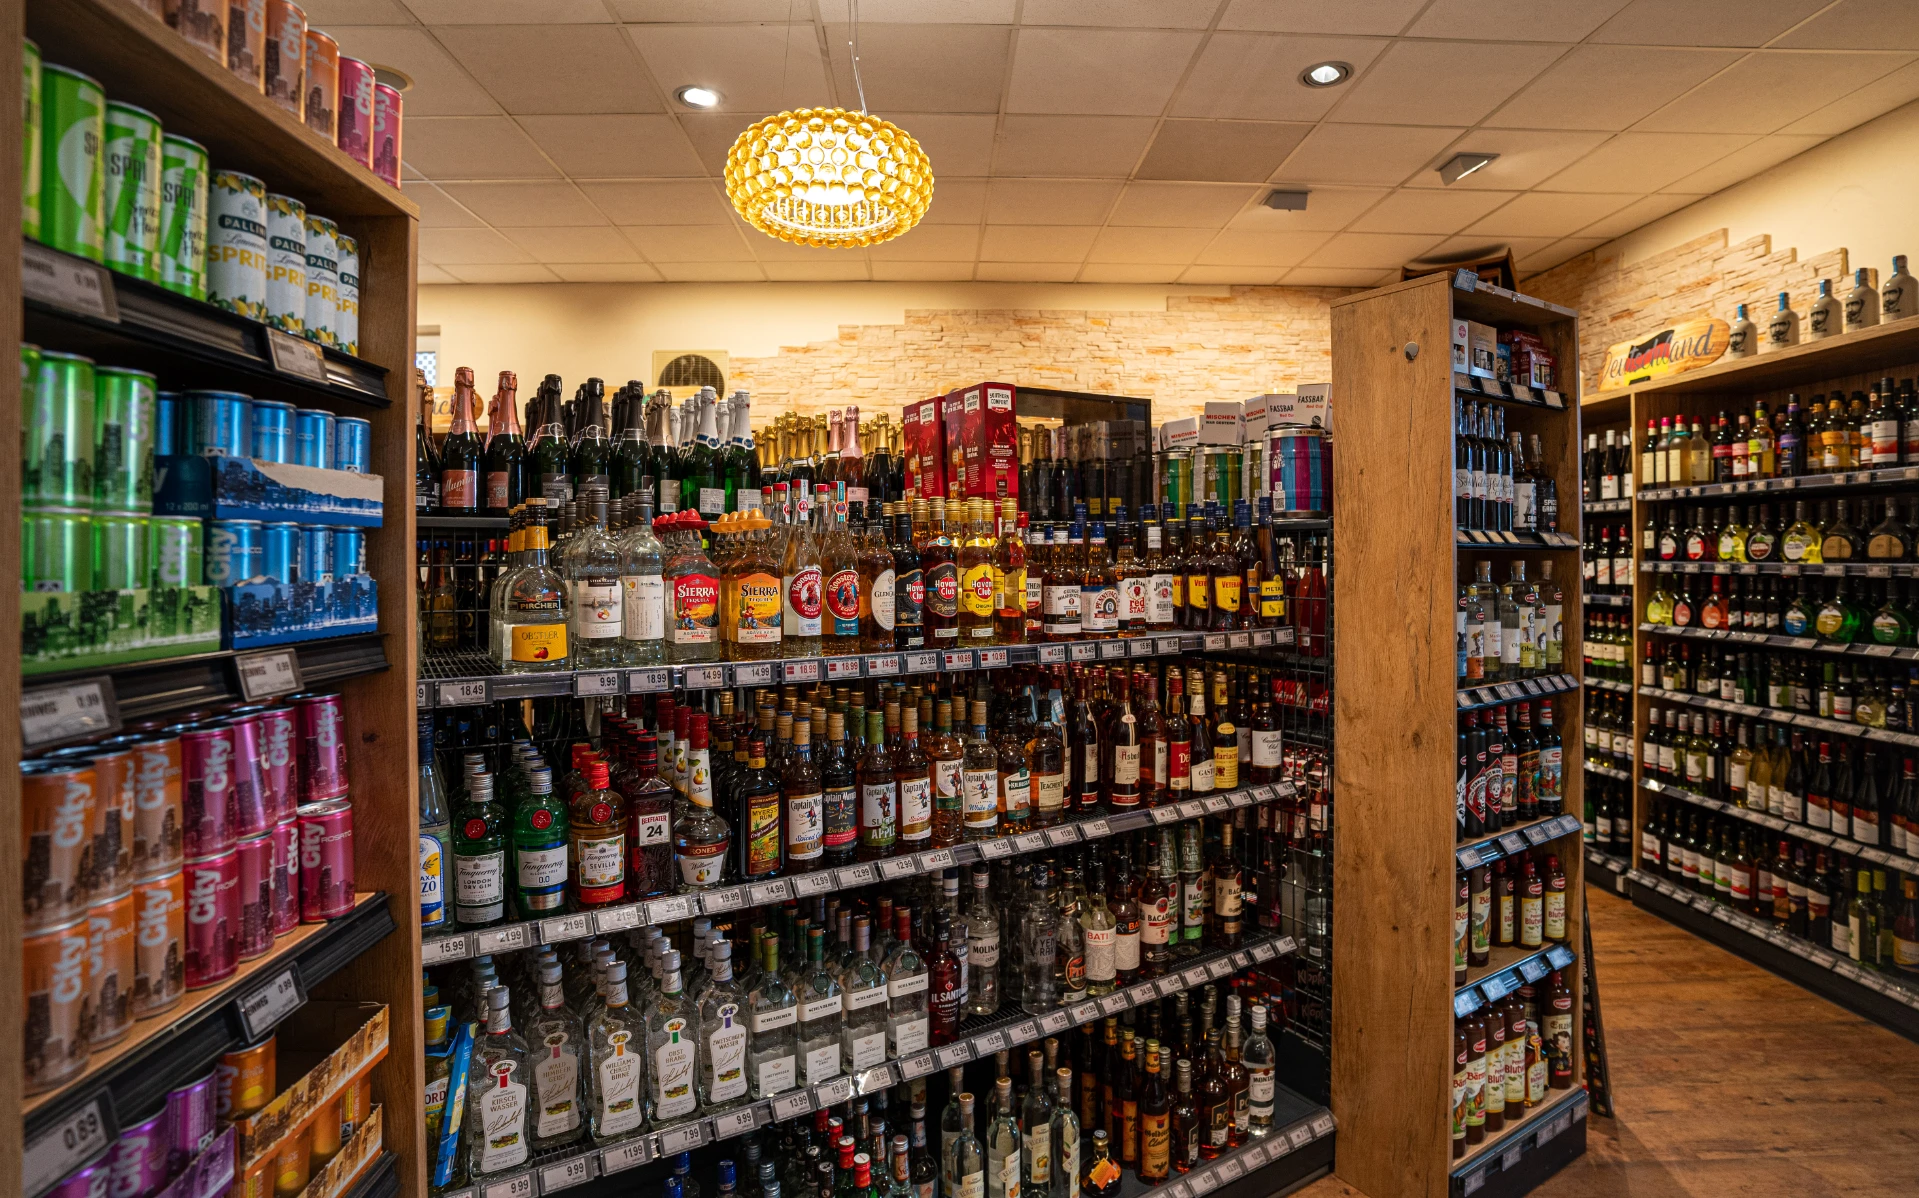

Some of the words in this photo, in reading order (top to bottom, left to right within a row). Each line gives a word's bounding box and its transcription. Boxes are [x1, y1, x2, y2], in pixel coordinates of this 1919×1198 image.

[281, 8, 302, 61] City
[355, 69, 374, 117] City
[374, 89, 392, 132] City
[1297, 395, 1324, 404] FASSBAR
[1245, 407, 1266, 418] MISCHEN
[1269, 404, 1294, 413] FASSBAR
[1171, 430, 1197, 440] MISCHEN
[677, 583, 715, 598] SIERRA
[740, 583, 779, 597] SIERRA
[941, 587, 955, 596] Club
[977, 587, 991, 596] Club
[520, 602, 559, 610] PIRCHER
[1130, 597, 1145, 607] red
[521, 630, 559, 641] OBSTLER
[842, 661, 859, 672] 18.99
[881, 659, 898, 669] 14.99
[919, 656, 936, 666] 23.99
[750, 666, 771, 678] 14.99
[799, 664, 817, 674] 18.99
[646, 673, 667, 684] 18.99
[702, 670, 722, 680] 14.99
[600, 675, 616, 687] 9.99
[1906, 701, 1915, 729] MERLOT
[318, 703, 339, 748] City
[268, 717, 293, 767] City
[204, 739, 232, 793] City
[137, 751, 170, 812] City
[965, 772, 984, 782] Captain
[866, 787, 886, 796] Captain
[903, 782, 923, 794] Captain
[790, 798, 813, 811] Captain
[52, 781, 92, 848] City
[641, 814, 667, 825] BEEFEATER
[759, 813, 773, 821] RUM
[646, 825, 664, 838] 24
[871, 824, 896, 840] APPLE
[302, 822, 326, 869] City
[1026, 835, 1042, 845] 14.99
[689, 846, 718, 855] RONER
[806, 841, 819, 851] 0.0
[993, 841, 1009, 851] 12.99
[586, 852, 618, 861] Tanqueray
[522, 858, 565, 872] Tanqueray
[589, 861, 616, 870] SEVILLA
[896, 861, 913, 870] 12.99
[458, 866, 498, 878] Tanqueray
[853, 869, 870, 879] 12.99
[538, 875, 551, 884] 0.0
[811, 877, 829, 887] 12.99
[765, 884, 785, 895] 14.99
[189, 869, 222, 926] City
[721, 892, 740, 903] 19.99
[139, 888, 172, 948] City
[1087, 931, 1109, 941] BATI
[439, 940, 464, 953] 15.99
[53, 936, 87, 1005] City
[855, 991, 883, 1003] SCHLADERER
[931, 993, 939, 1003] IL
[1112, 996, 1125, 1006] 24.99
[760, 1012, 792, 1024] SCHLADERER
[1051, 1014, 1067, 1026] 18.99
[1020, 1024, 1035, 1035] 15.99
[712, 1032, 745, 1047] ZWETSCHGEN
[718, 1039, 739, 1051] WASSER
[987, 1034, 1002, 1046] 13.99
[668, 1048, 683, 1057] OBST
[951, 1045, 968, 1057] 12.99
[605, 1057, 636, 1070] WILLIAMS
[665, 1053, 687, 1063] BRAND
[915, 1057, 931, 1068] 19.99
[547, 1061, 567, 1070] WALD
[609, 1065, 632, 1075] CHRIST
[543, 1066, 572, 1077] HIMBEER
[610, 1071, 630, 1081] BIRNE
[548, 1073, 566, 1082] GEIST
[831, 1083, 849, 1096] 19.99
[491, 1094, 517, 1105] KIRSCH
[789, 1097, 808, 1110] 13.99
[490, 1101, 519, 1112] WASSER
[736, 1112, 752, 1126] 9.99
[63, 1112, 99, 1151] 0.89
[682, 1127, 700, 1142] 7.99
[567, 1162, 585, 1177] 9.99
[510, 1179, 529, 1194] 9.99
